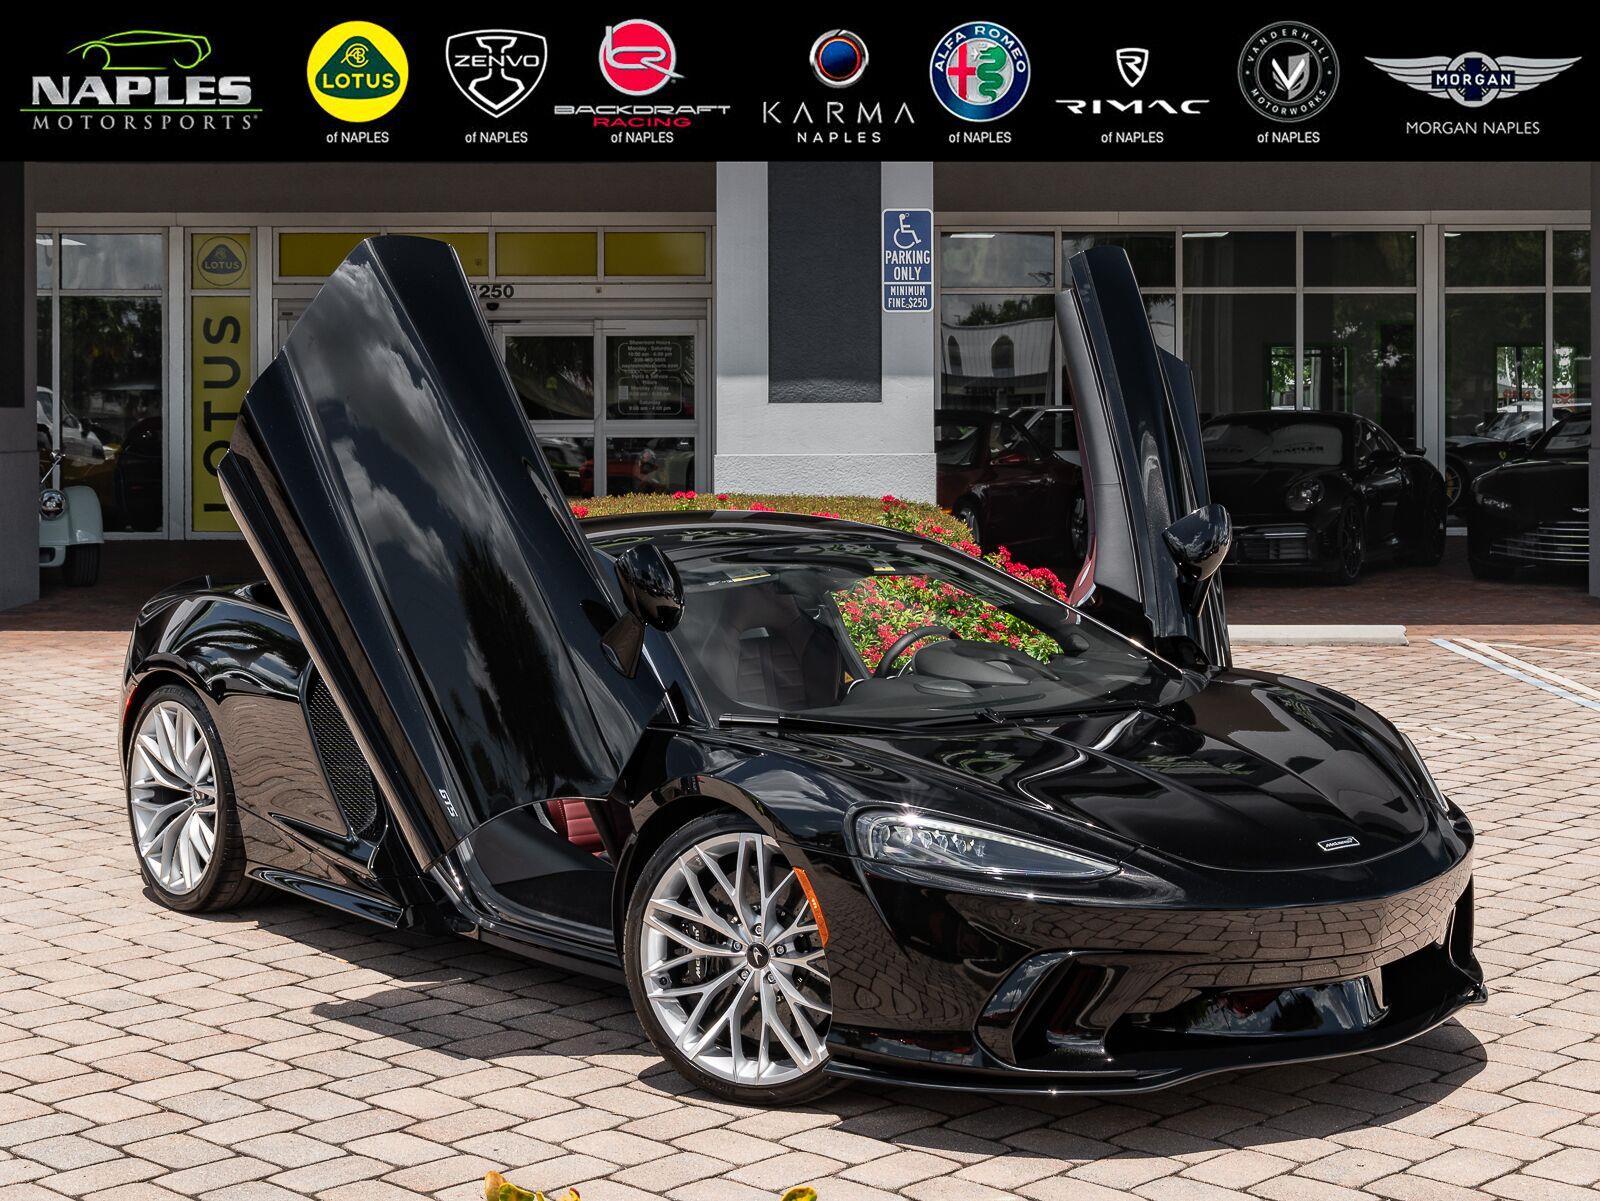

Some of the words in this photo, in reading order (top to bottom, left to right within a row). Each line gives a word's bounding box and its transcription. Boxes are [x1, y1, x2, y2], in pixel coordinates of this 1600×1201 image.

[885, 250, 931, 265] PARKING
[204, 261, 240, 270] LOTUS
[893, 266, 922, 281] ONLY
[890, 285, 925, 296] MINIMUM
[888, 297, 906, 308] FINE
[908, 297, 928, 309] $250
[438, 788, 459, 817] GTS
